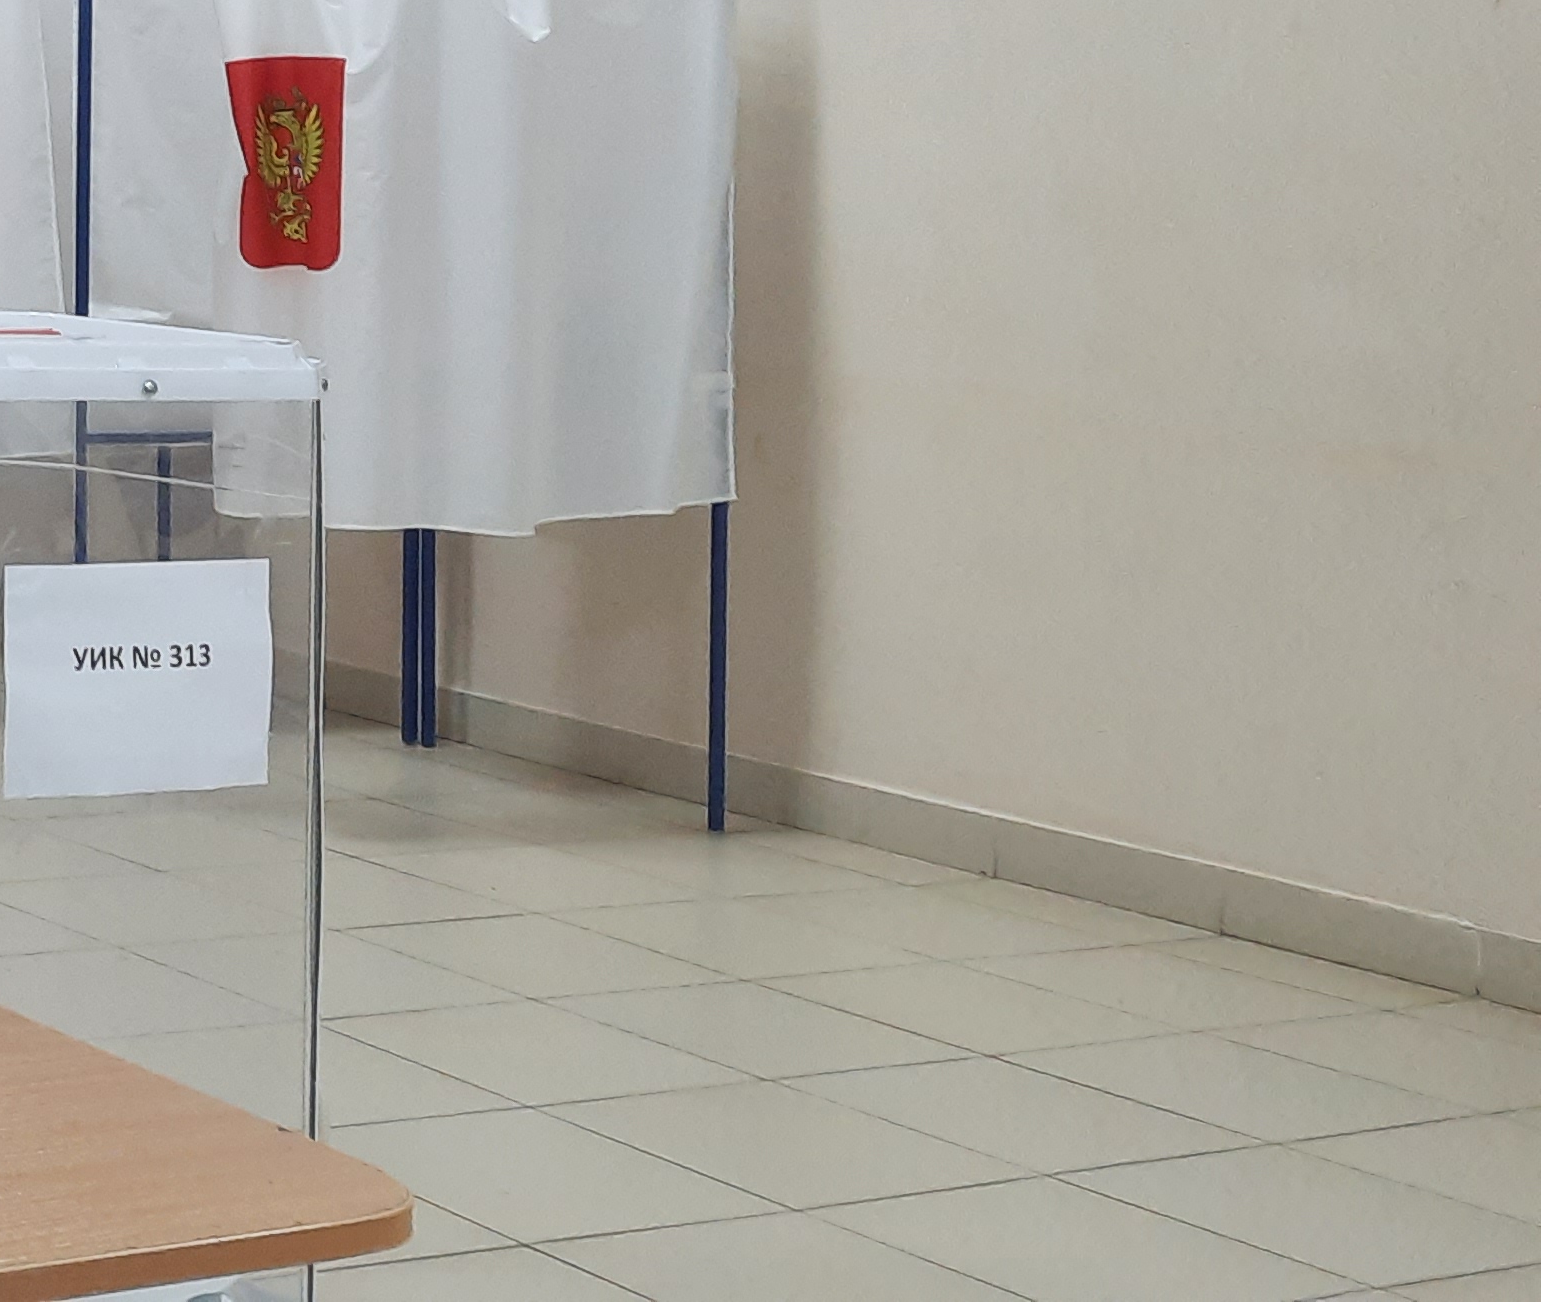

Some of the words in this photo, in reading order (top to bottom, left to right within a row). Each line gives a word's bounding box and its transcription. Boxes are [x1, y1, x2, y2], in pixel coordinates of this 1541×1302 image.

[72, 646, 125, 672] УИК
[132, 645, 162, 670] №
[168, 643, 211, 668] 313
